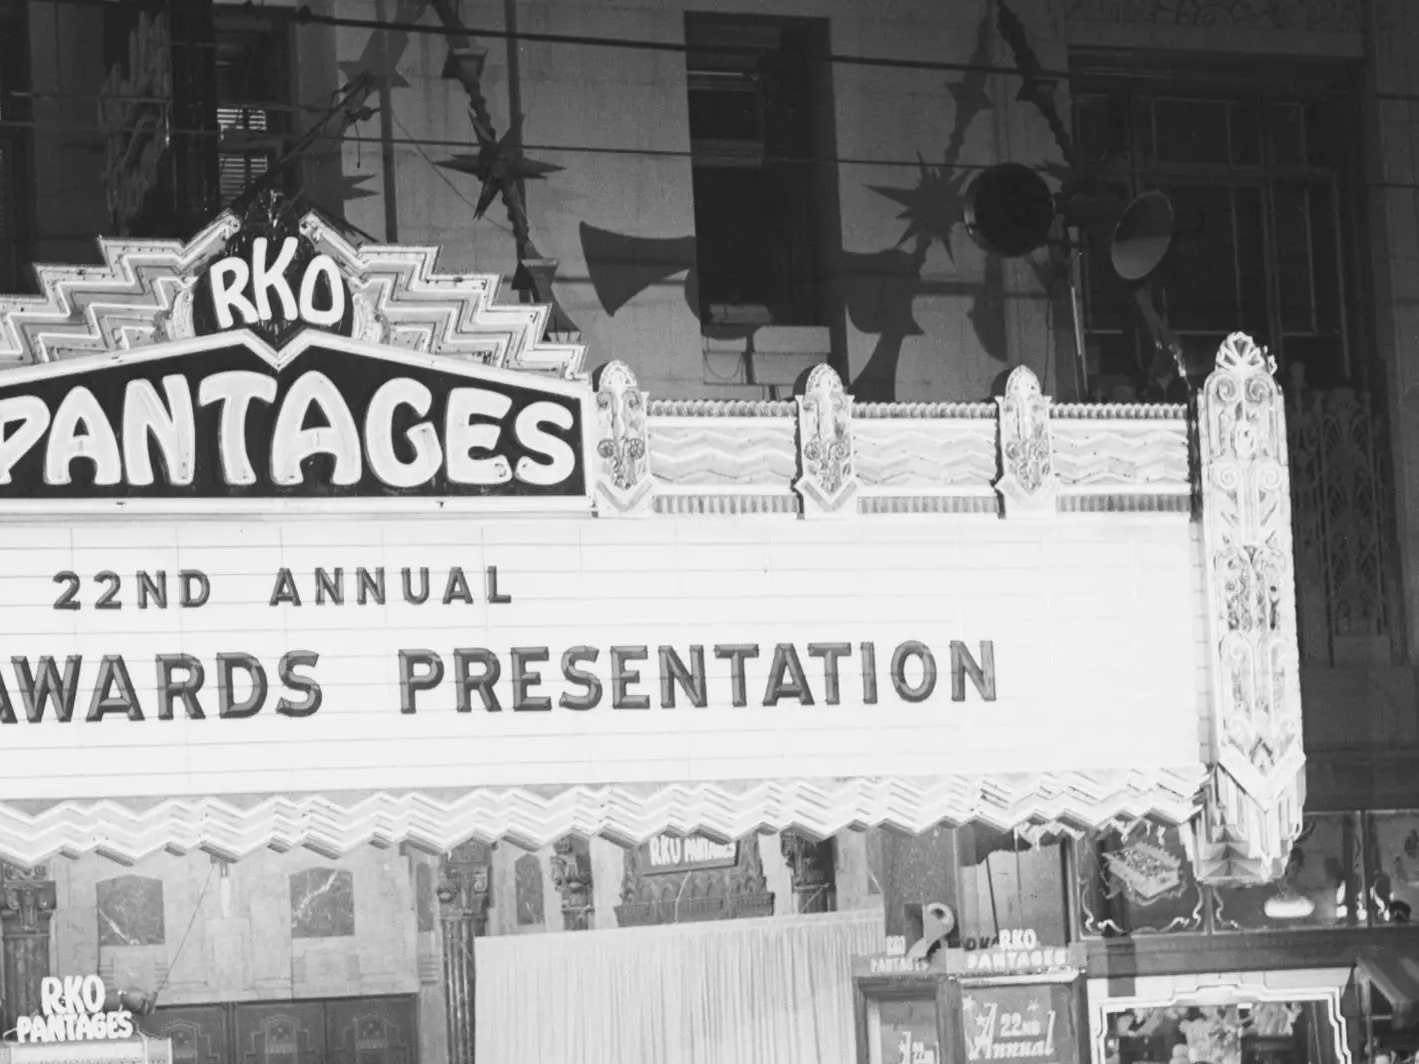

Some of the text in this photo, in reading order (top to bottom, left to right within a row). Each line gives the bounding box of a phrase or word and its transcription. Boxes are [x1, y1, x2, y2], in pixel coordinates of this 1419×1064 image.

[209, 236, 345, 328] RKO
[53, 565, 513, 611] 22ND ANNUAL
[398, 640, 997, 714] PRESENTATION
[966, 950, 1070, 971] PANTAGES
[998, 928, 1037, 951] RKO
[40, 974, 106, 1016] RKO
[16, 1010, 133, 1044] PANTAGES
